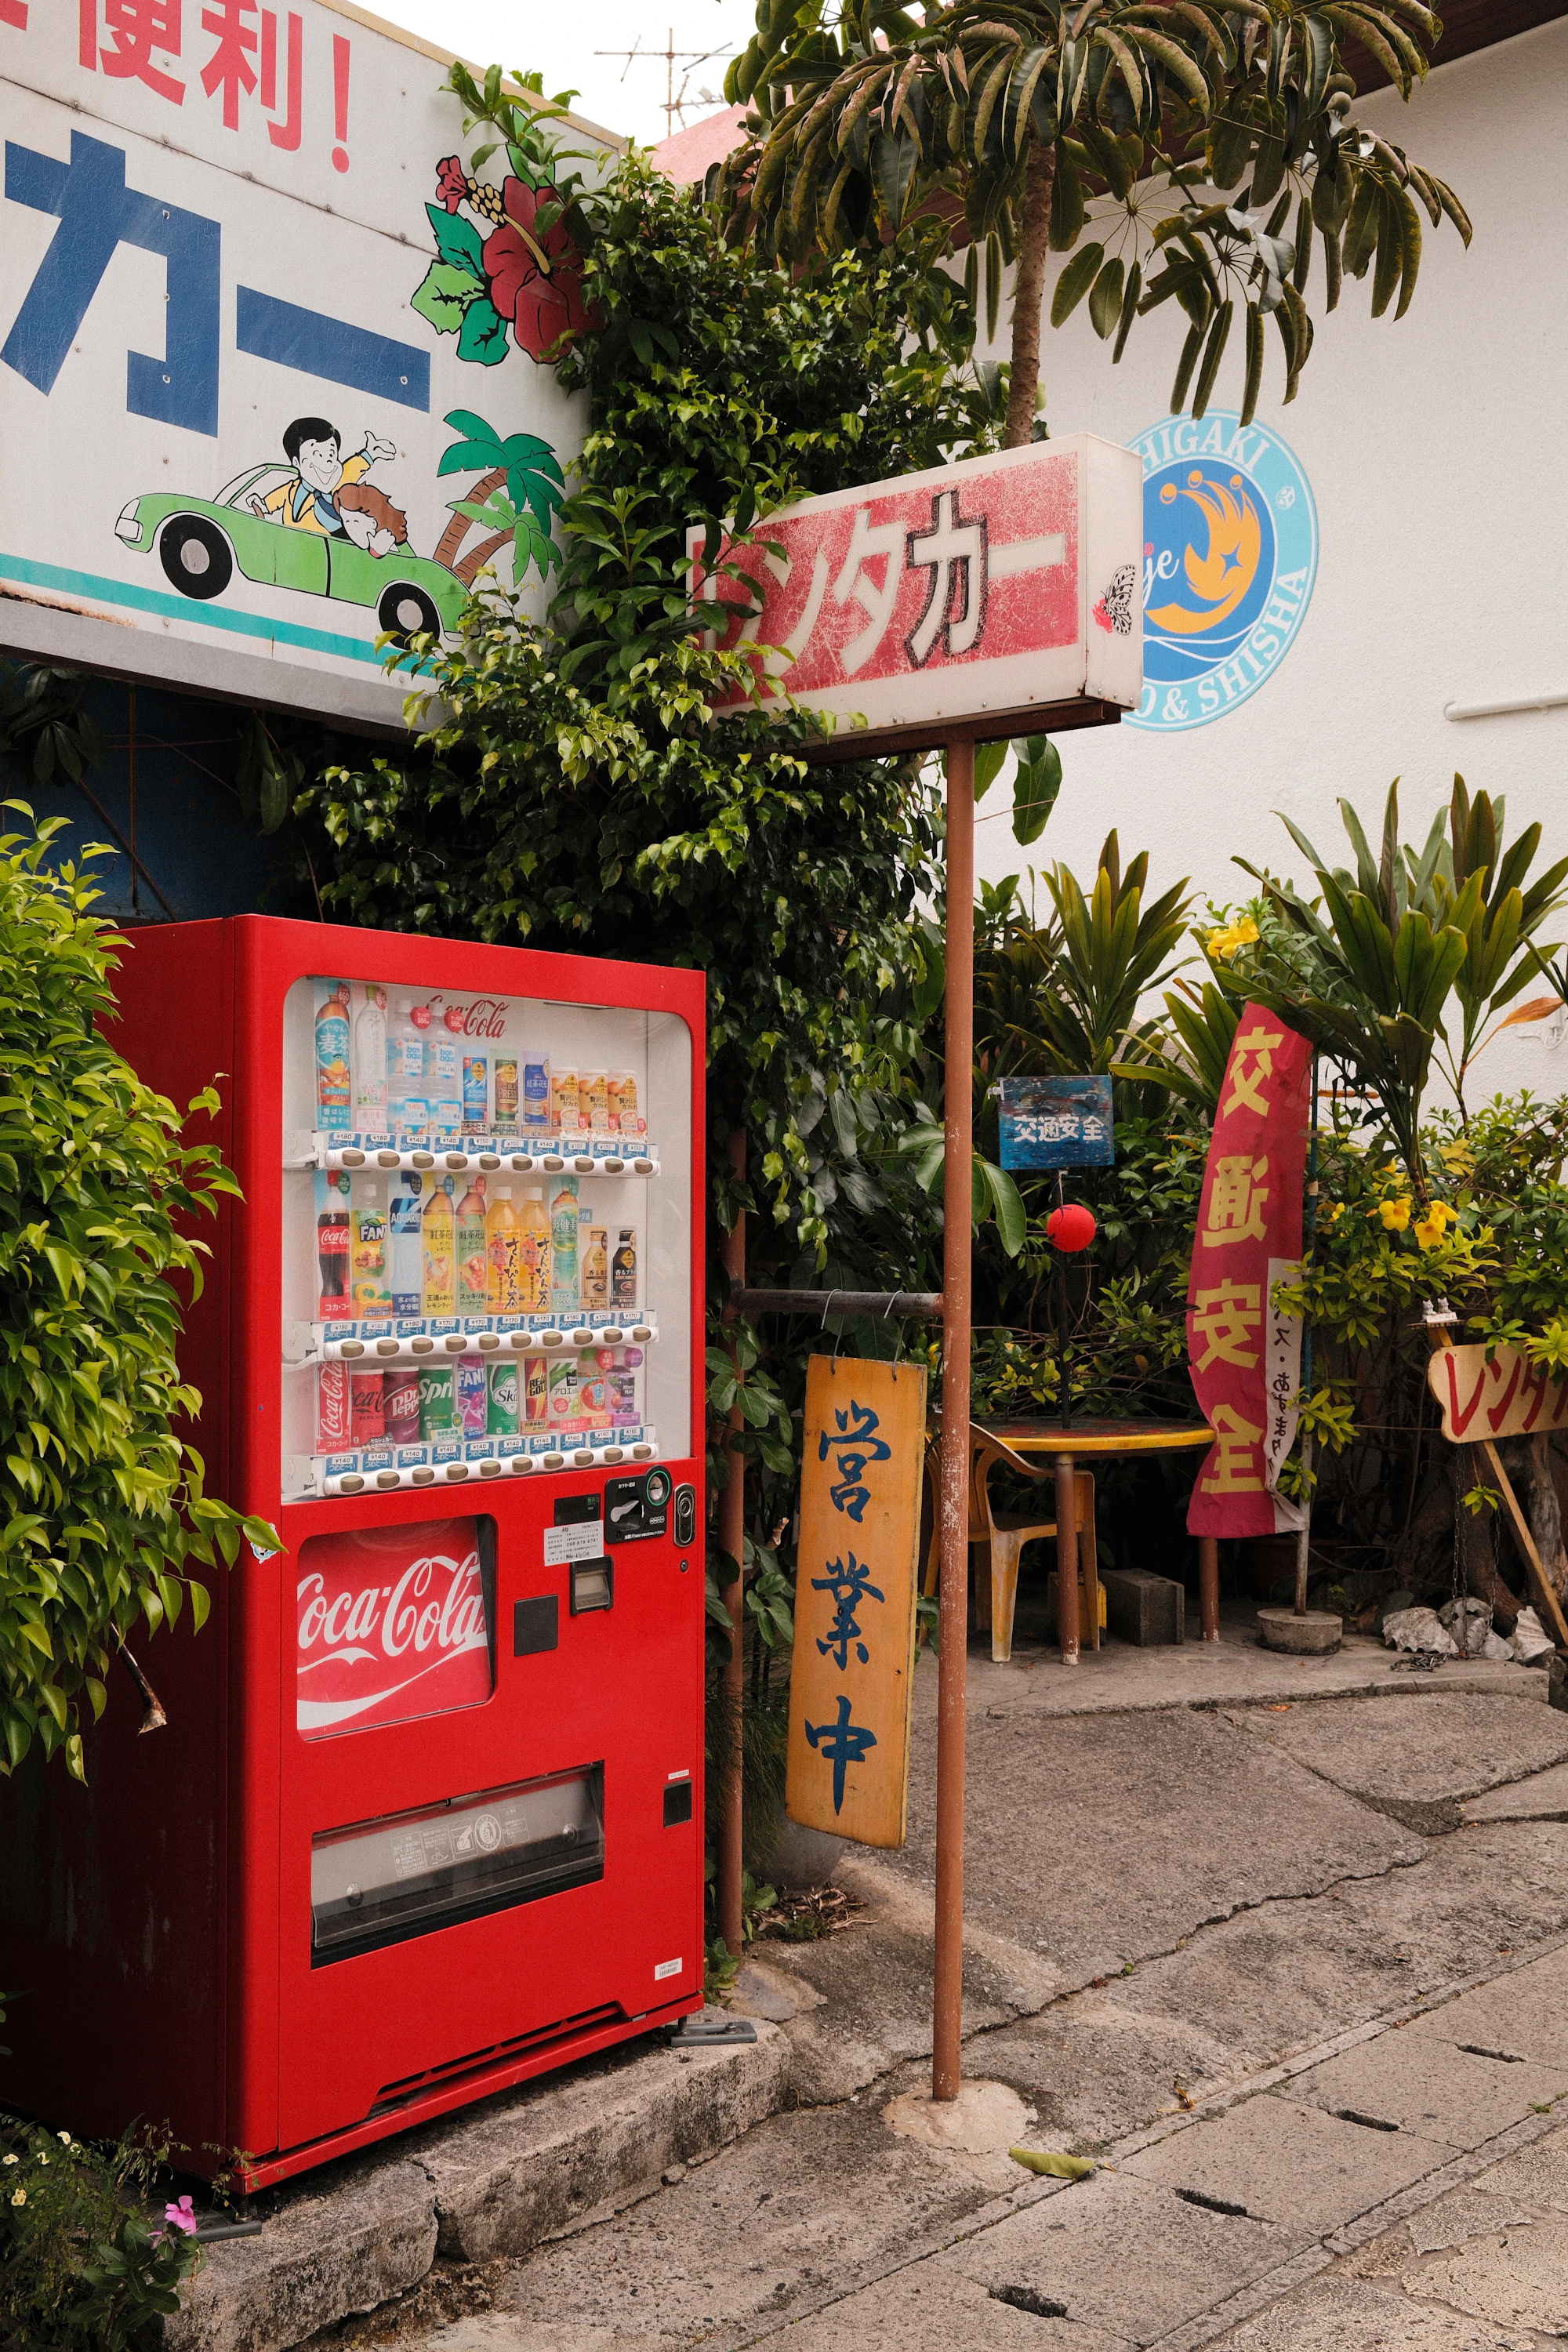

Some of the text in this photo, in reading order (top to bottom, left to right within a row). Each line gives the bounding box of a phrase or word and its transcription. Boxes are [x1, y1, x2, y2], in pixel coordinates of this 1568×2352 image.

[0, 0, 350, 173] 便利!
[1163, 688, 1189, 722] &
[1196, 566, 1308, 715] SHISHA
[1013, 1113, 1104, 1143] 交通安全
[1444, 1352, 1568, 1439] レンタ
[804, 1399, 892, 1817] 営業中
